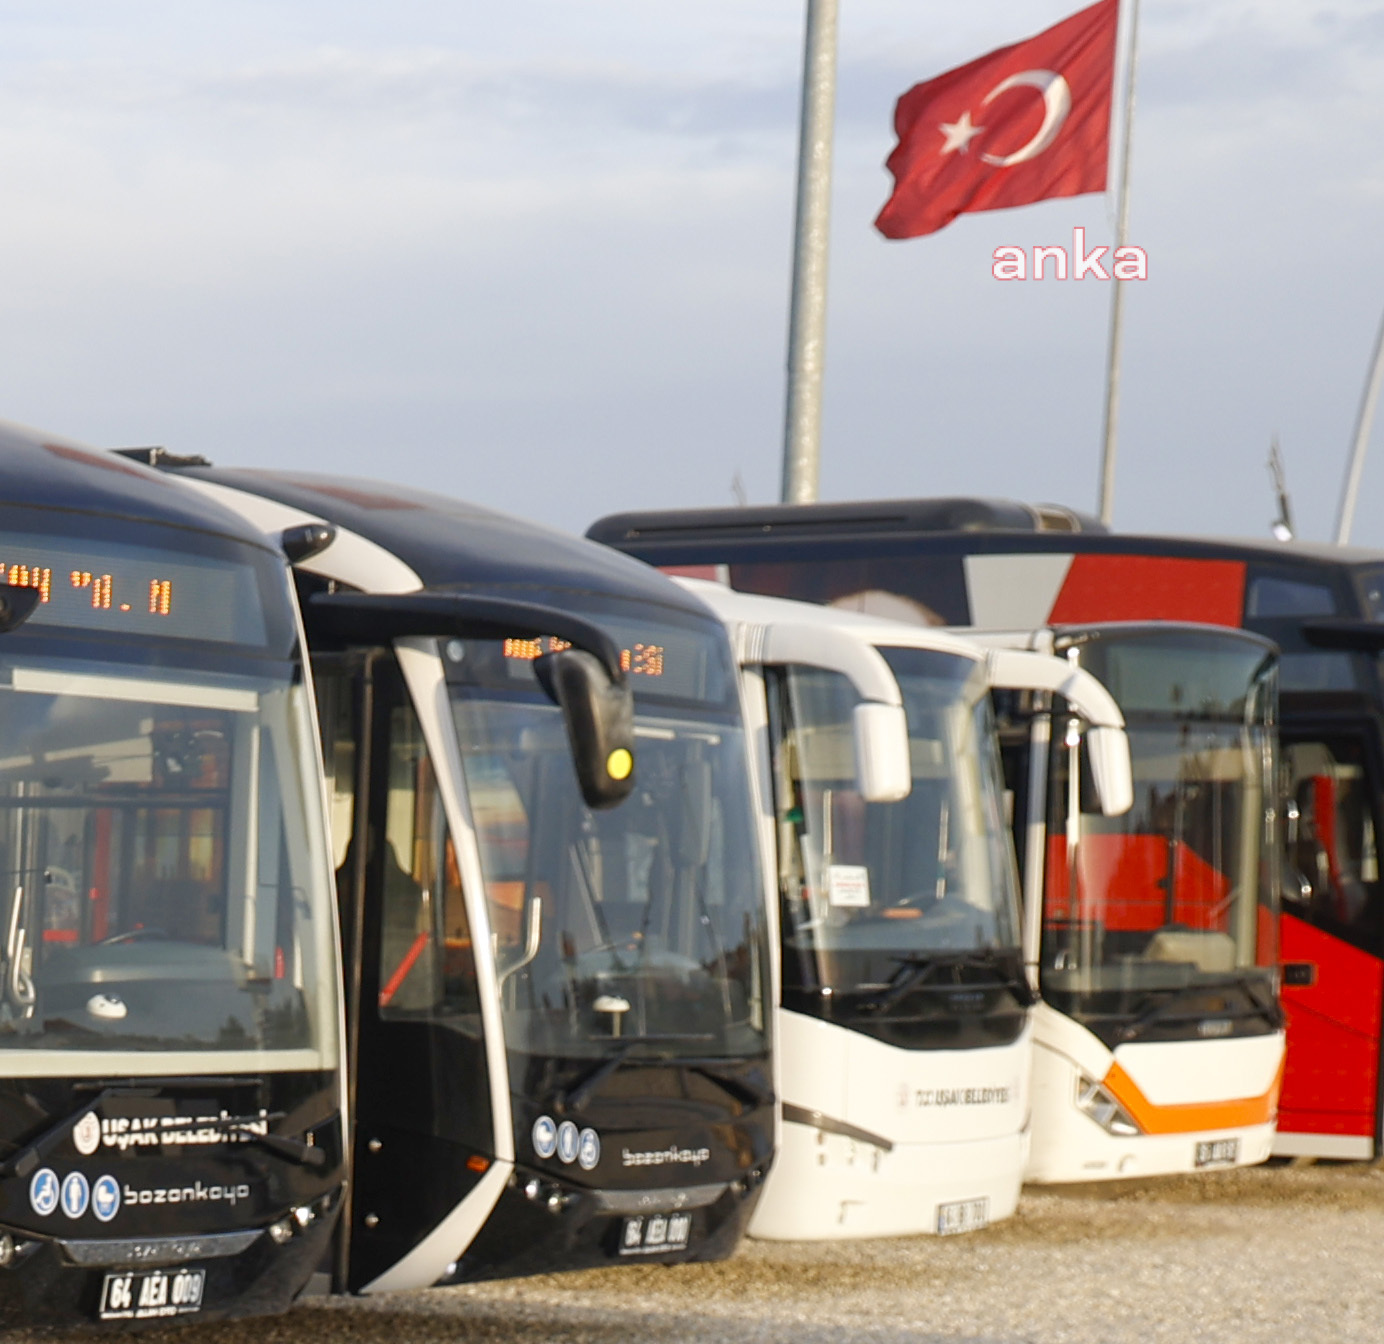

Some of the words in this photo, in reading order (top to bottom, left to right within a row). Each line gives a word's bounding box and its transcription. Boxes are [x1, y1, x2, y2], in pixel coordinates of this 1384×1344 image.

[123, 1181, 250, 1206] bozankaya
[109, 1277, 133, 1309] 64
[138, 1275, 168, 1306] AEA
